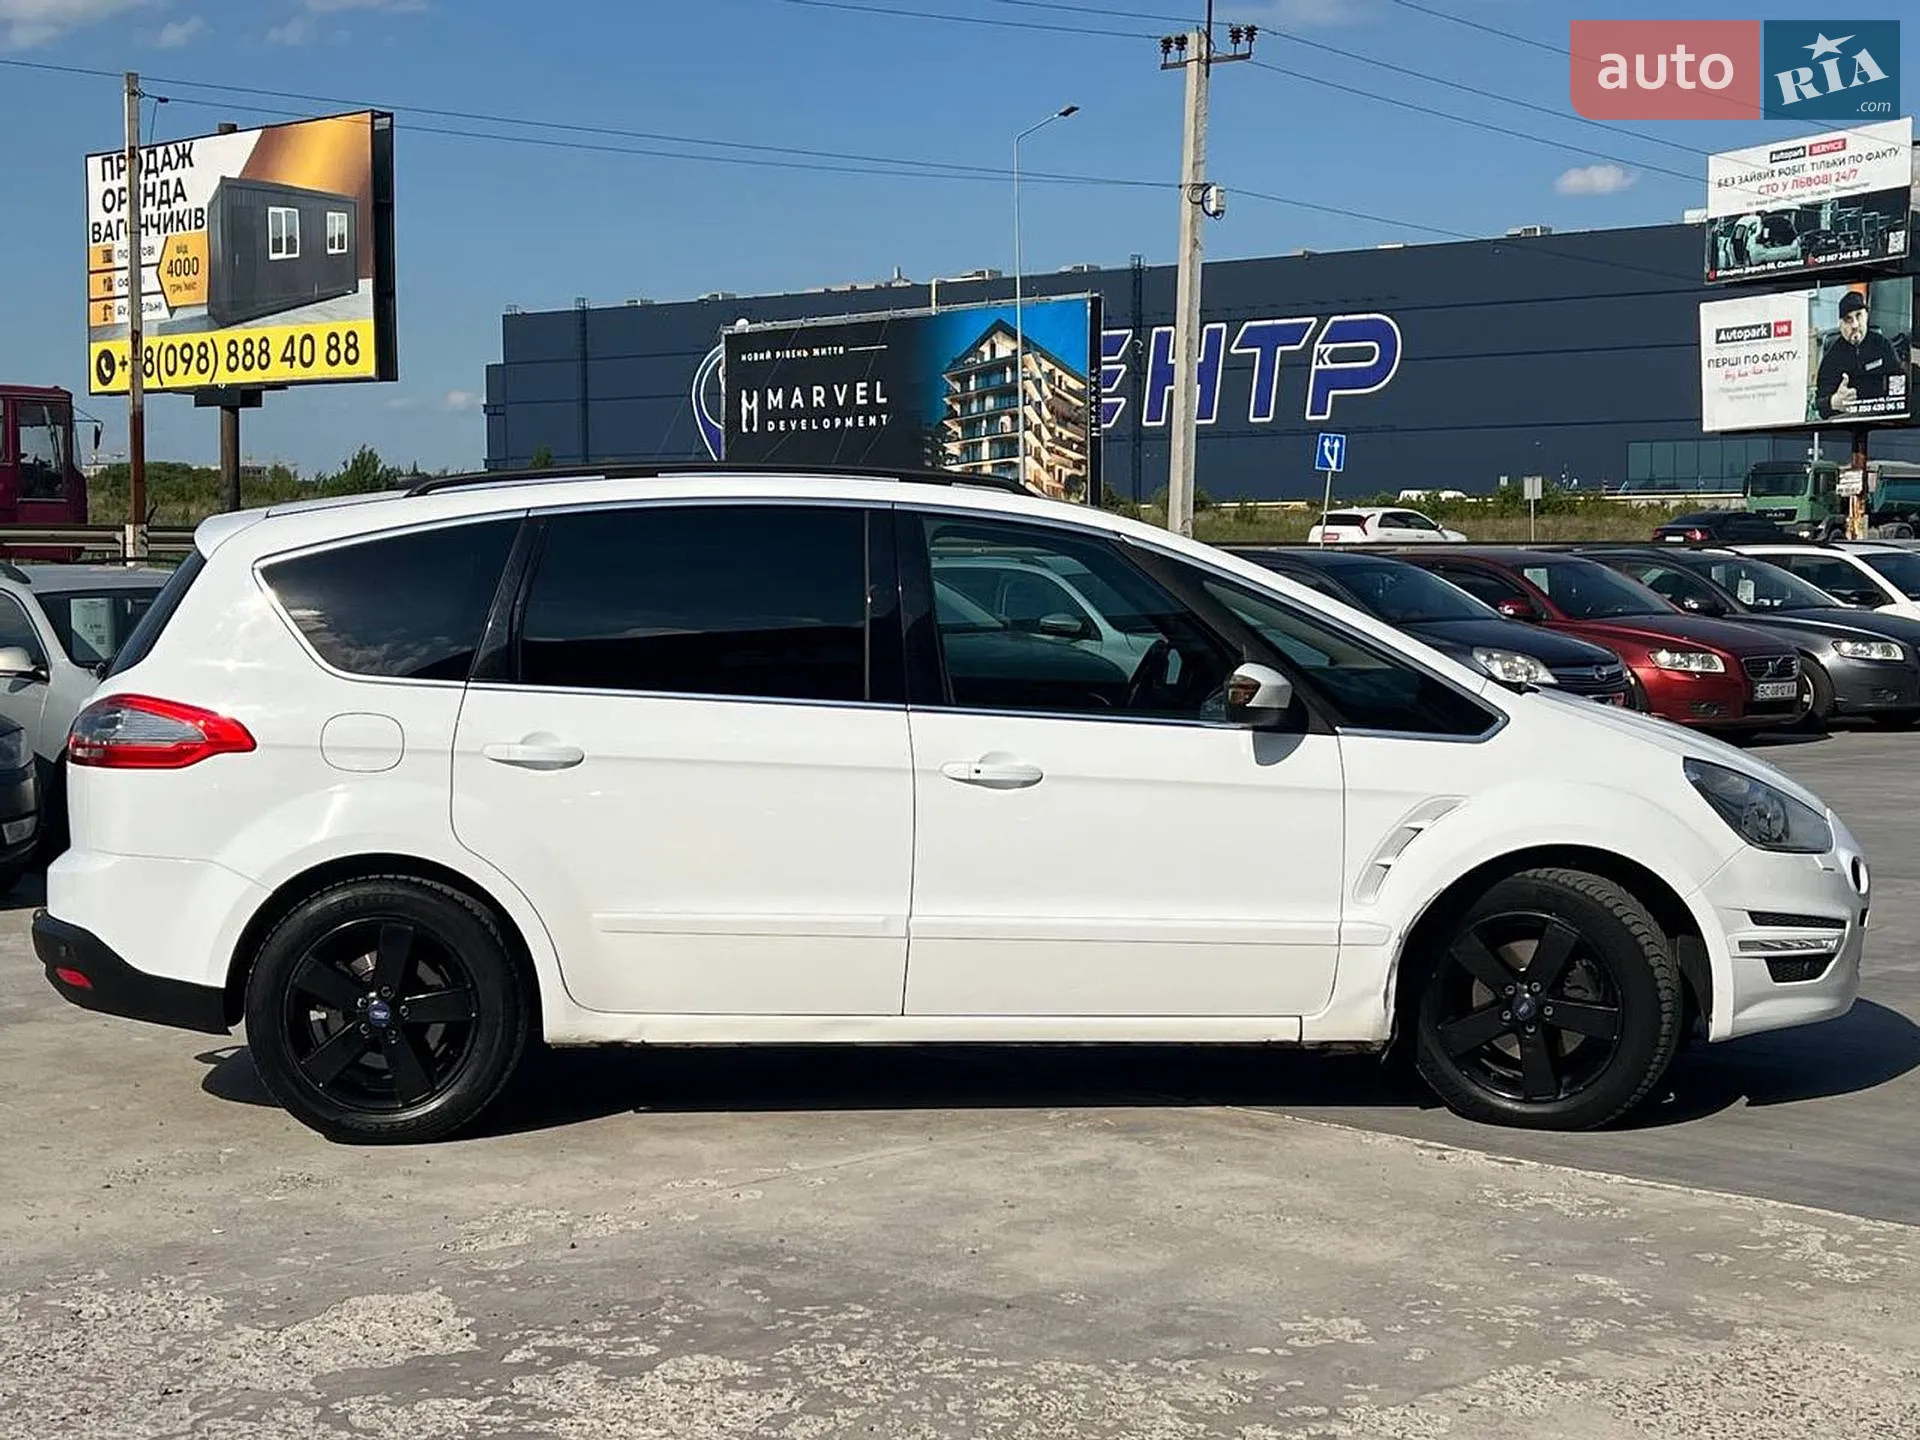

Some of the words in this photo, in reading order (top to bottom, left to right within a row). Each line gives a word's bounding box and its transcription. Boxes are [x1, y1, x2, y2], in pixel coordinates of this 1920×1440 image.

[102, 177, 187, 214] ОРНДА
[1757, 182, 1780, 195] СТО
[167, 256, 199, 277] 4000
[1718, 324, 1769, 341] Autopark
[119, 337, 218, 387] +8(098)
[226, 336, 270, 373] 888
[280, 333, 315, 369] 40
[326, 330, 359, 367] 88
[1707, 355, 1742, 369] ПЕРШІ
[1744, 353, 1760, 365] ПО
[767, 380, 888, 411] MARVEL
[767, 414, 888, 432] DEVELOPMENT
